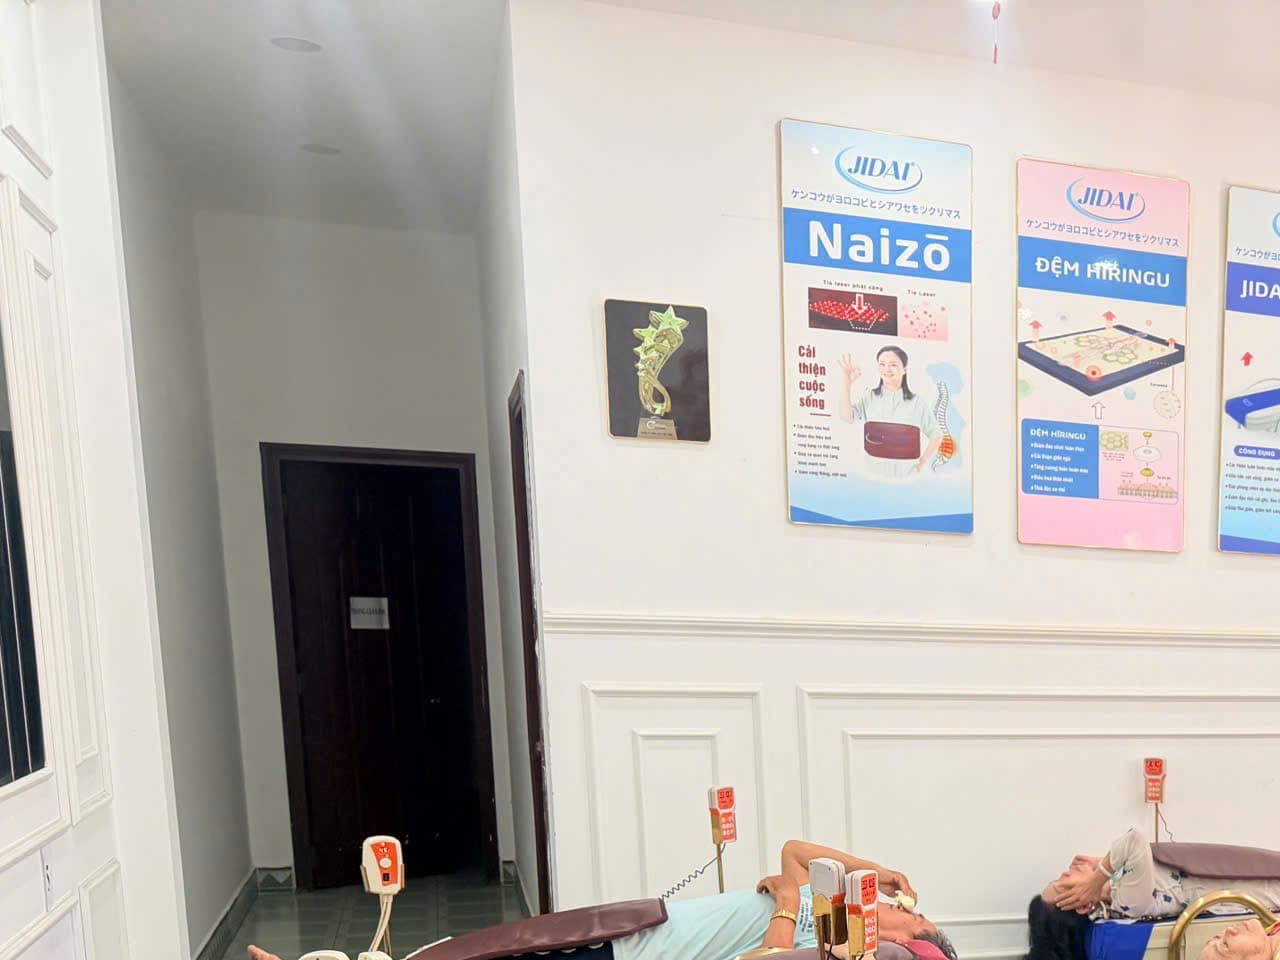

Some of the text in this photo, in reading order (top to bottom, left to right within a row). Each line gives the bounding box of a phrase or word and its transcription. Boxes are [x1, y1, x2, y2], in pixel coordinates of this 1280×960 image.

[848, 156, 911, 181] JIDAI
[1078, 187, 1135, 211] JIDAI
[809, 220, 950, 272] Naizō
[1035, 256, 1080, 279] ĐỆM
[798, 344, 816, 358] Cải
[798, 362, 827, 378] thiện
[799, 380, 826, 394] cuộc
[799, 394, 825, 410] sống
